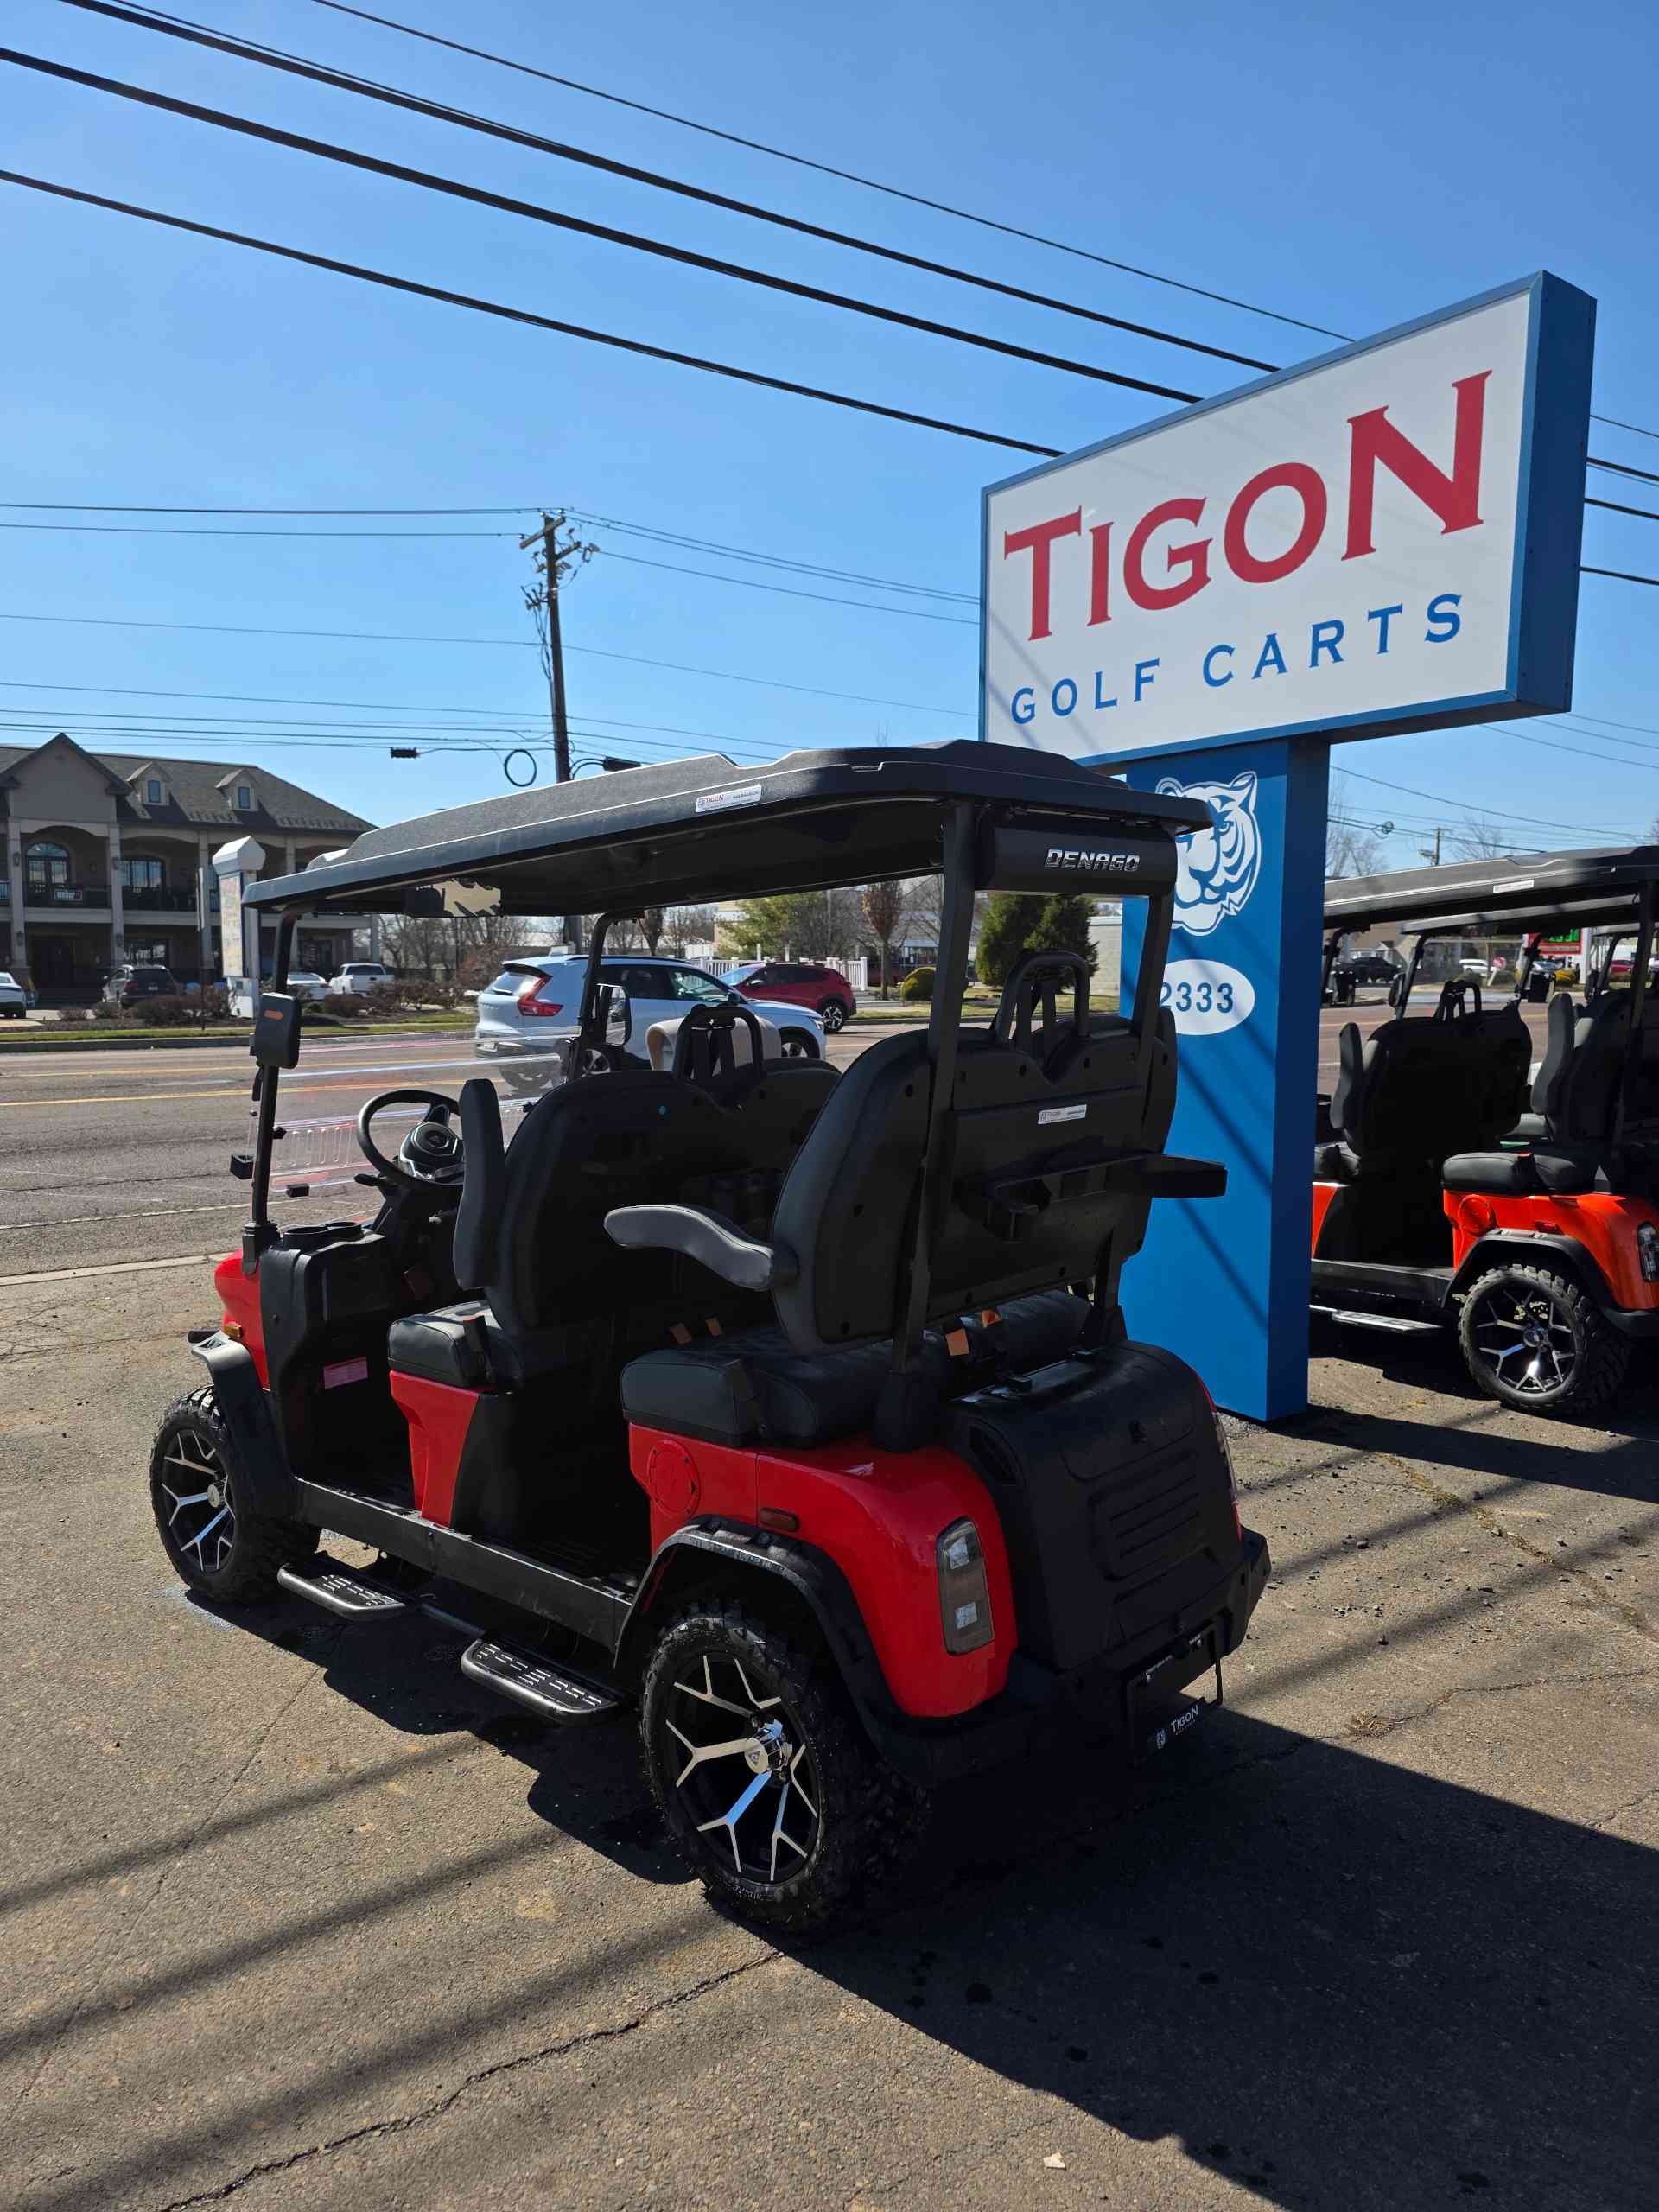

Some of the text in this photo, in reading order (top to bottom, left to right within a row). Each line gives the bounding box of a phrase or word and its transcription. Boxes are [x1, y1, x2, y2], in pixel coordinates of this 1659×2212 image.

[1004, 369, 1493, 641] TIGON
[1012, 593, 1463, 725] GOLF CARTS
[1044, 849, 1141, 872] DENAGO
[1160, 982, 1234, 1014] 2333
[1171, 1705, 1198, 1732] TIGON
